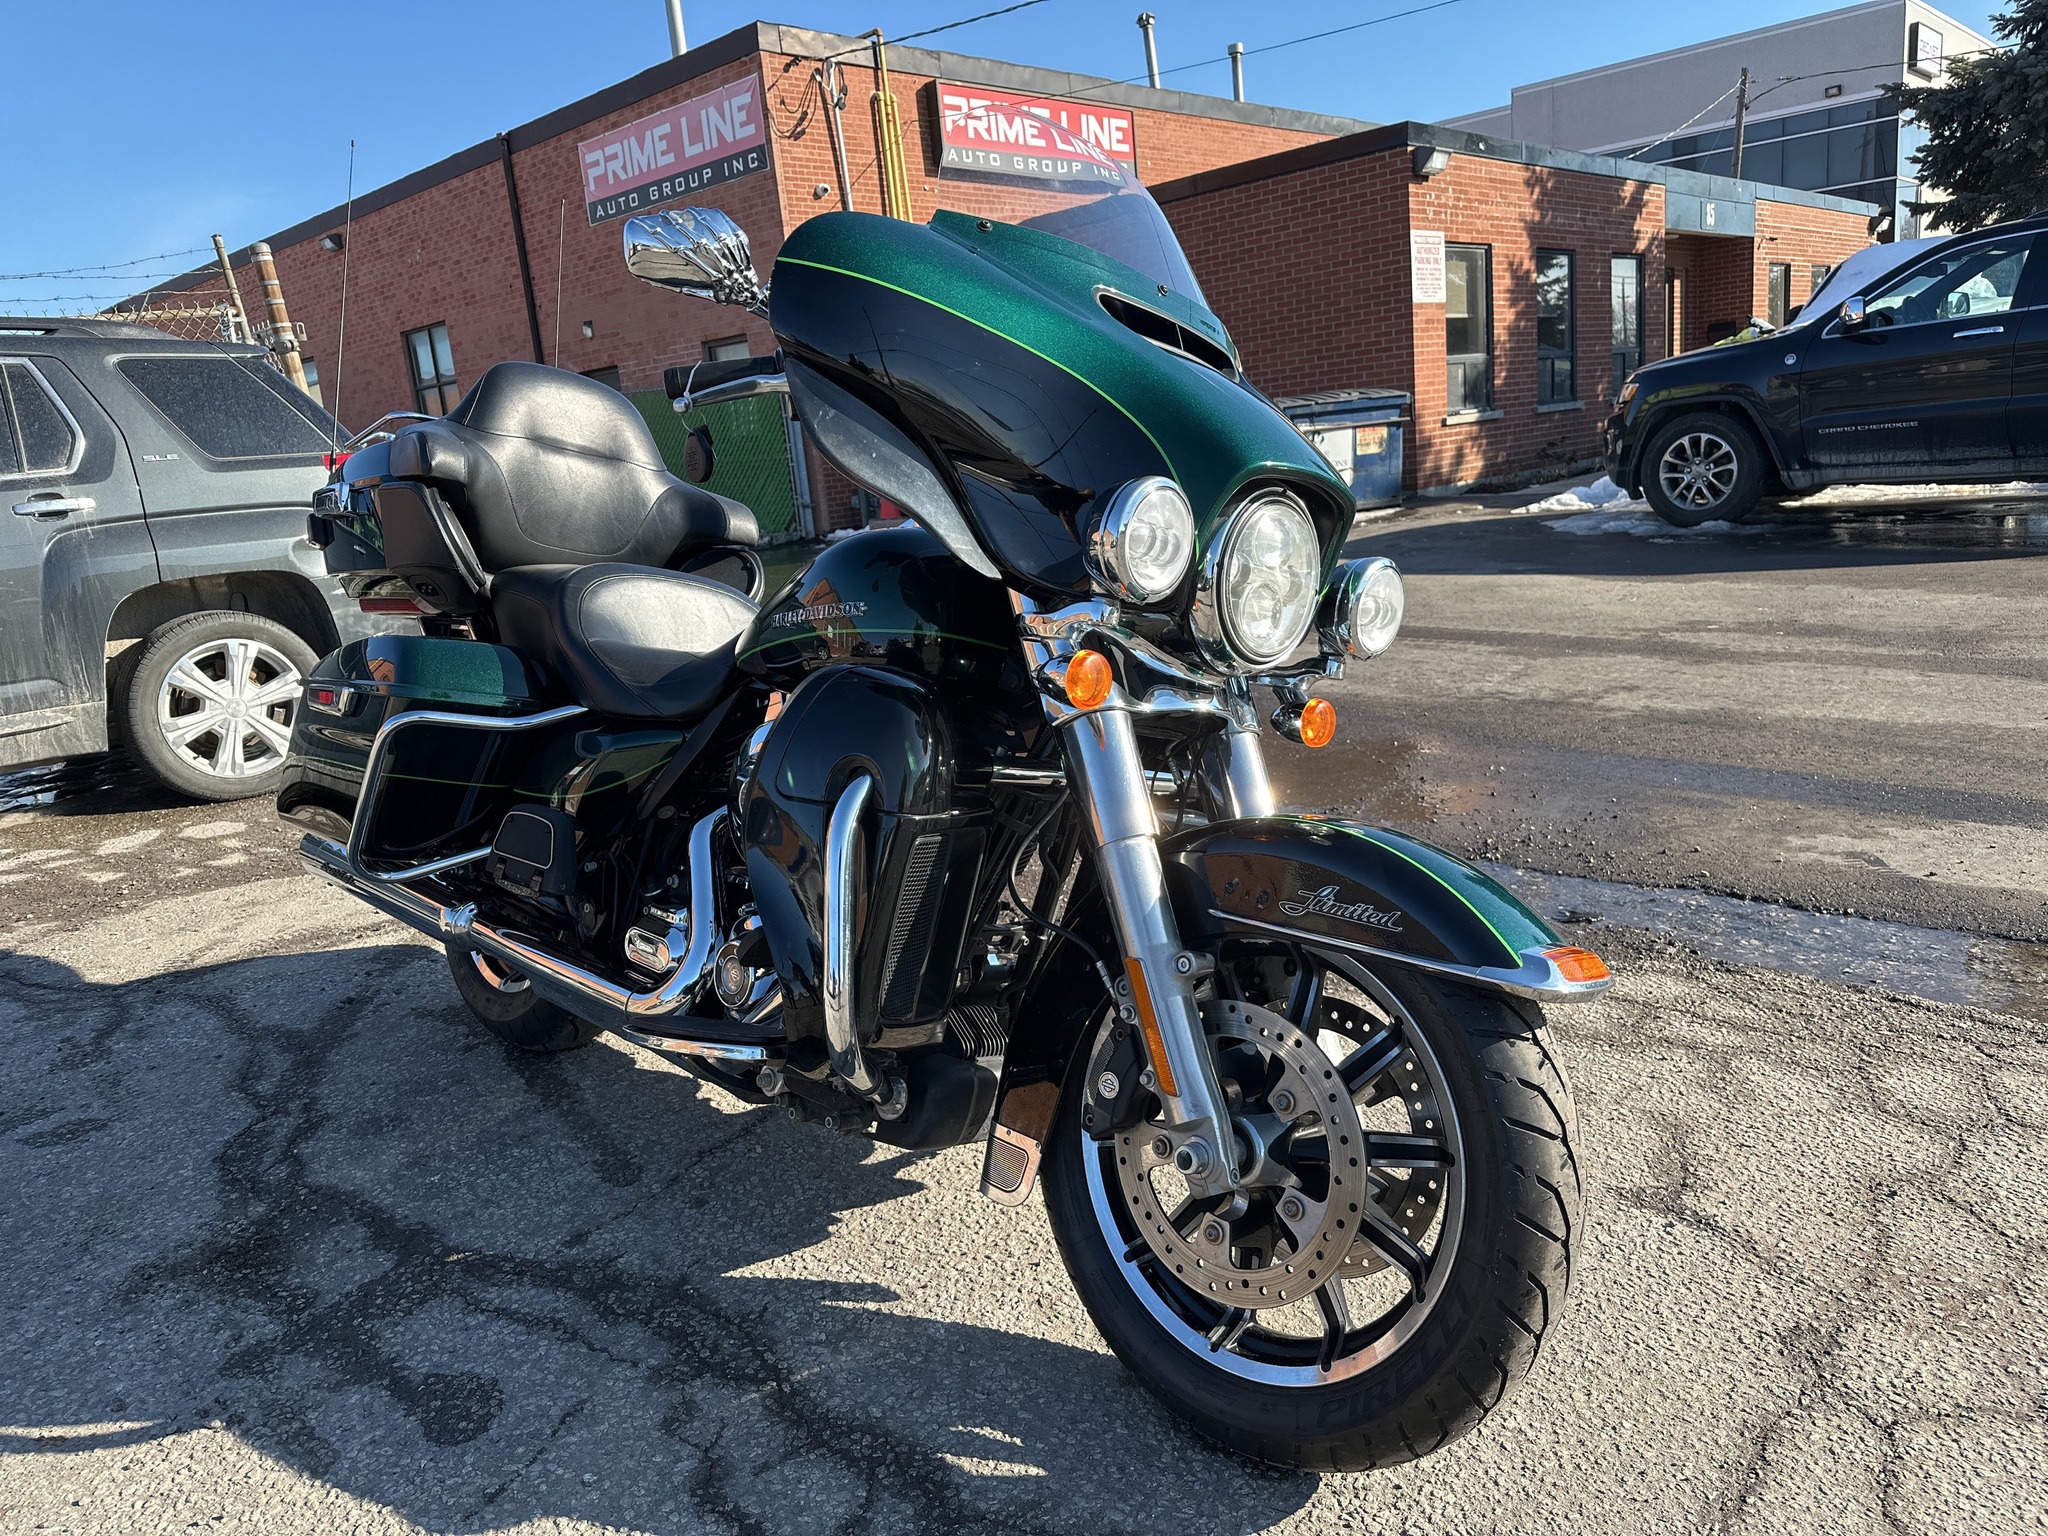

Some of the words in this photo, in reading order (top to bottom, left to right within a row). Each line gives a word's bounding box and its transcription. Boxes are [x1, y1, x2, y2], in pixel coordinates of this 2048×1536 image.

[585, 123, 675, 191] PRIME
[680, 92, 756, 157] LINE
[943, 94, 1050, 147] PRIME
[1050, 111, 1130, 158] LINE
[596, 193, 638, 218] AUTO
[649, 168, 711, 200] GROUP
[724, 153, 758, 176] INC
[947, 148, 1001, 167] AUTO
[1013, 156, 1082, 174] GROUP
[1094, 165, 1120, 181] INC
[1706, 202, 1715, 226] 85
[1818, 425, 1855, 434] GRAND
[1857, 421, 1919, 431] CHEROKEE
[143, 453, 179, 462] SLE
[1279, 885, 1403, 933] Limited
[1316, 1283, 1471, 1426] PIRELLI
